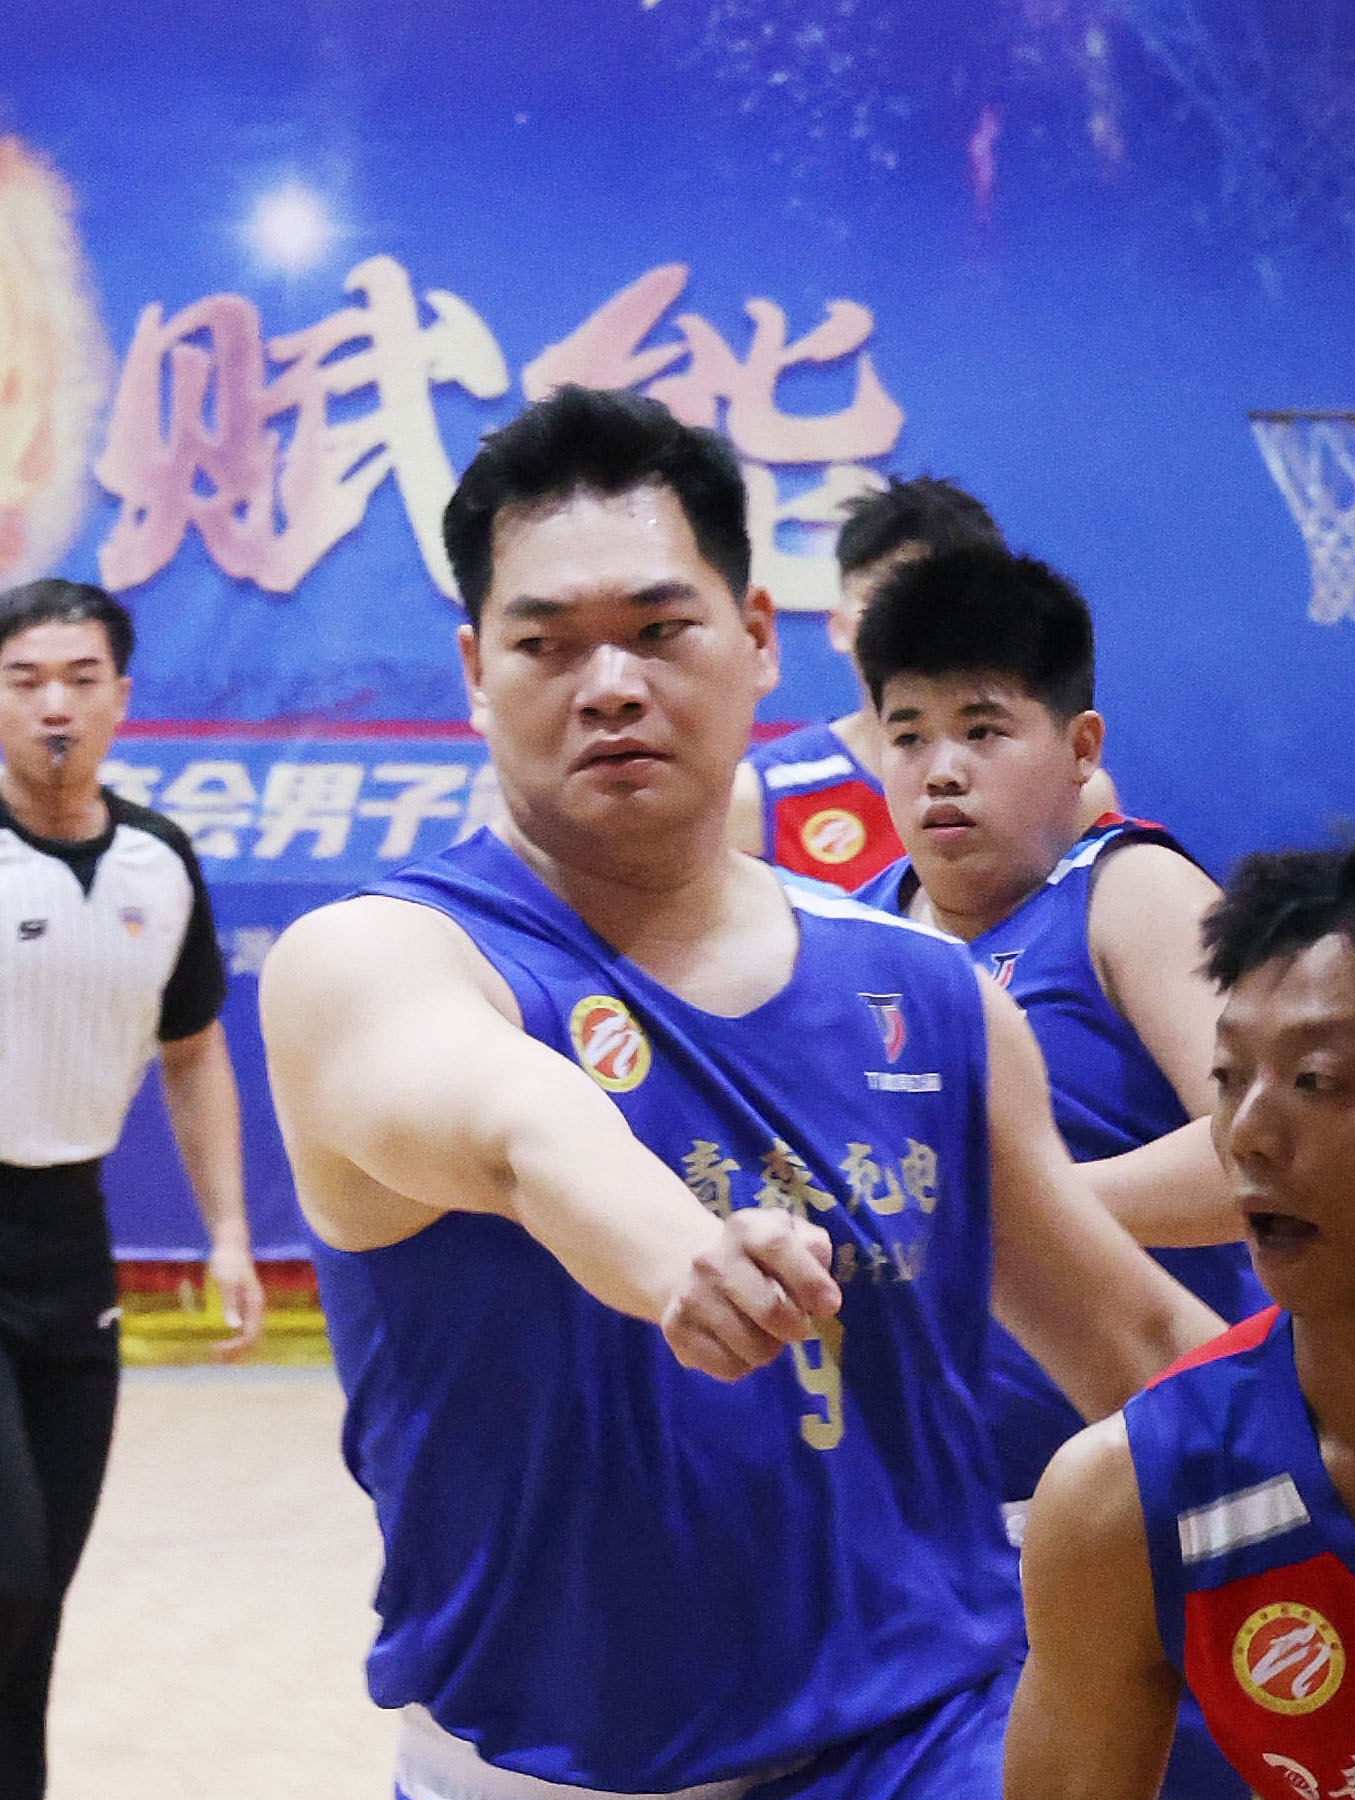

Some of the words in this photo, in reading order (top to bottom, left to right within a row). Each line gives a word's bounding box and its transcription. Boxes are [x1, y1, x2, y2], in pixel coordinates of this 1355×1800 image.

[97, 254, 905, 612] 赋能
[98, 760, 515, 860] 会男子
